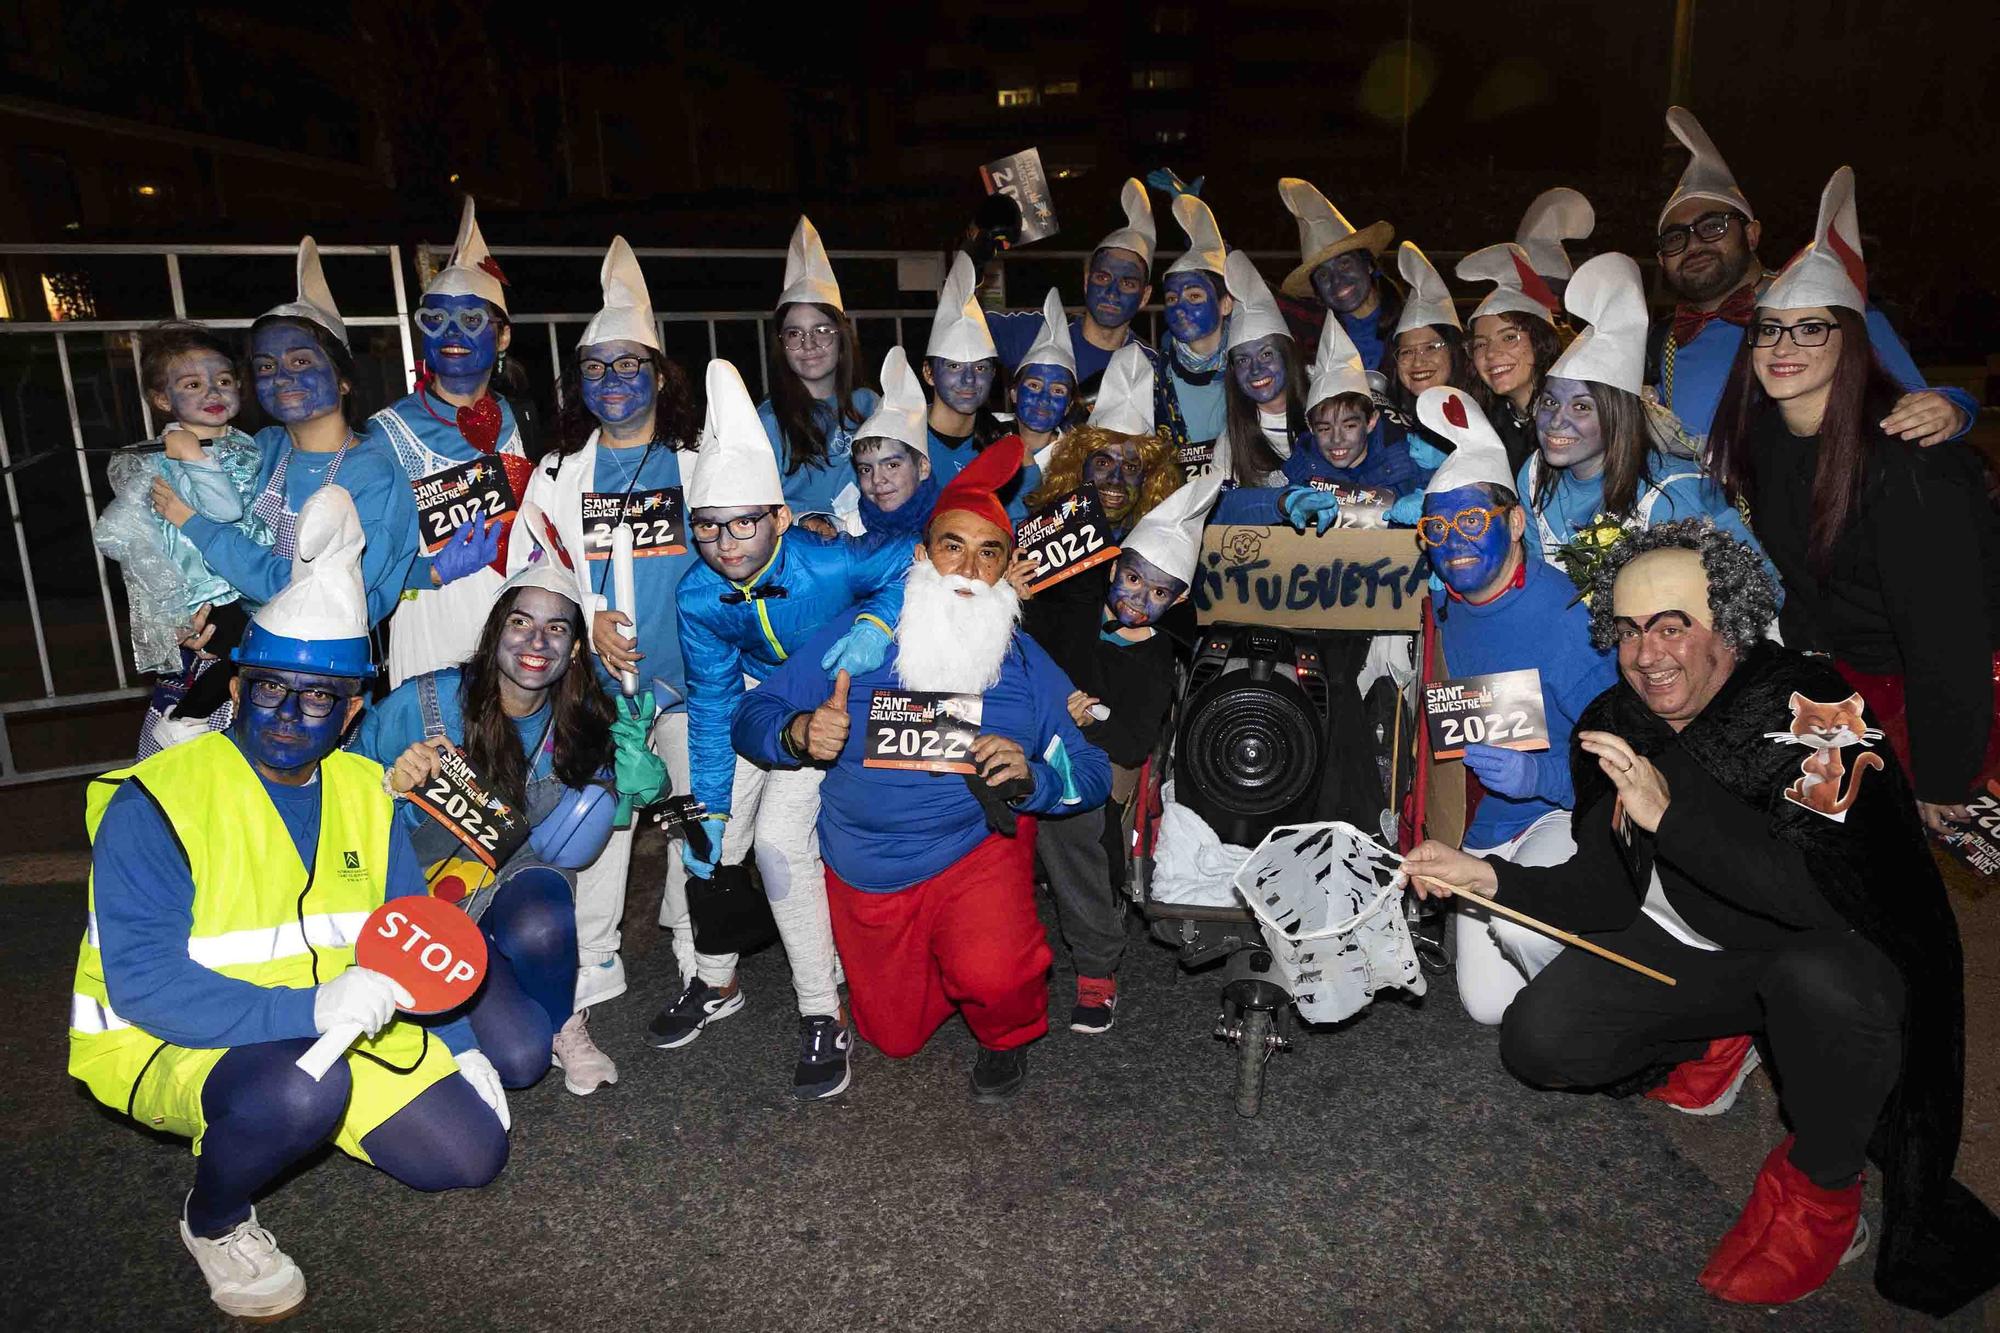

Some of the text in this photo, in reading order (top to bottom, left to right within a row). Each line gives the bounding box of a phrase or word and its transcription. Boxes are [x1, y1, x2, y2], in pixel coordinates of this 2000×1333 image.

[1179, 445, 1206, 457] SANT
[428, 490, 506, 538] 2022
[583, 498, 620, 510] SANT
[594, 519, 674, 548] 222
[1017, 515, 1043, 542] SANT
[1027, 524, 1104, 578] 2022
[872, 697, 912, 711] SANT
[1426, 685, 1465, 703] SANT
[877, 727, 966, 759] 2022
[1441, 711, 1534, 746] 2022
[442, 752, 477, 782] SANT
[425, 778, 499, 851] 2022
[1966, 851, 2000, 875] SANT
[377, 911, 476, 984] STOP
